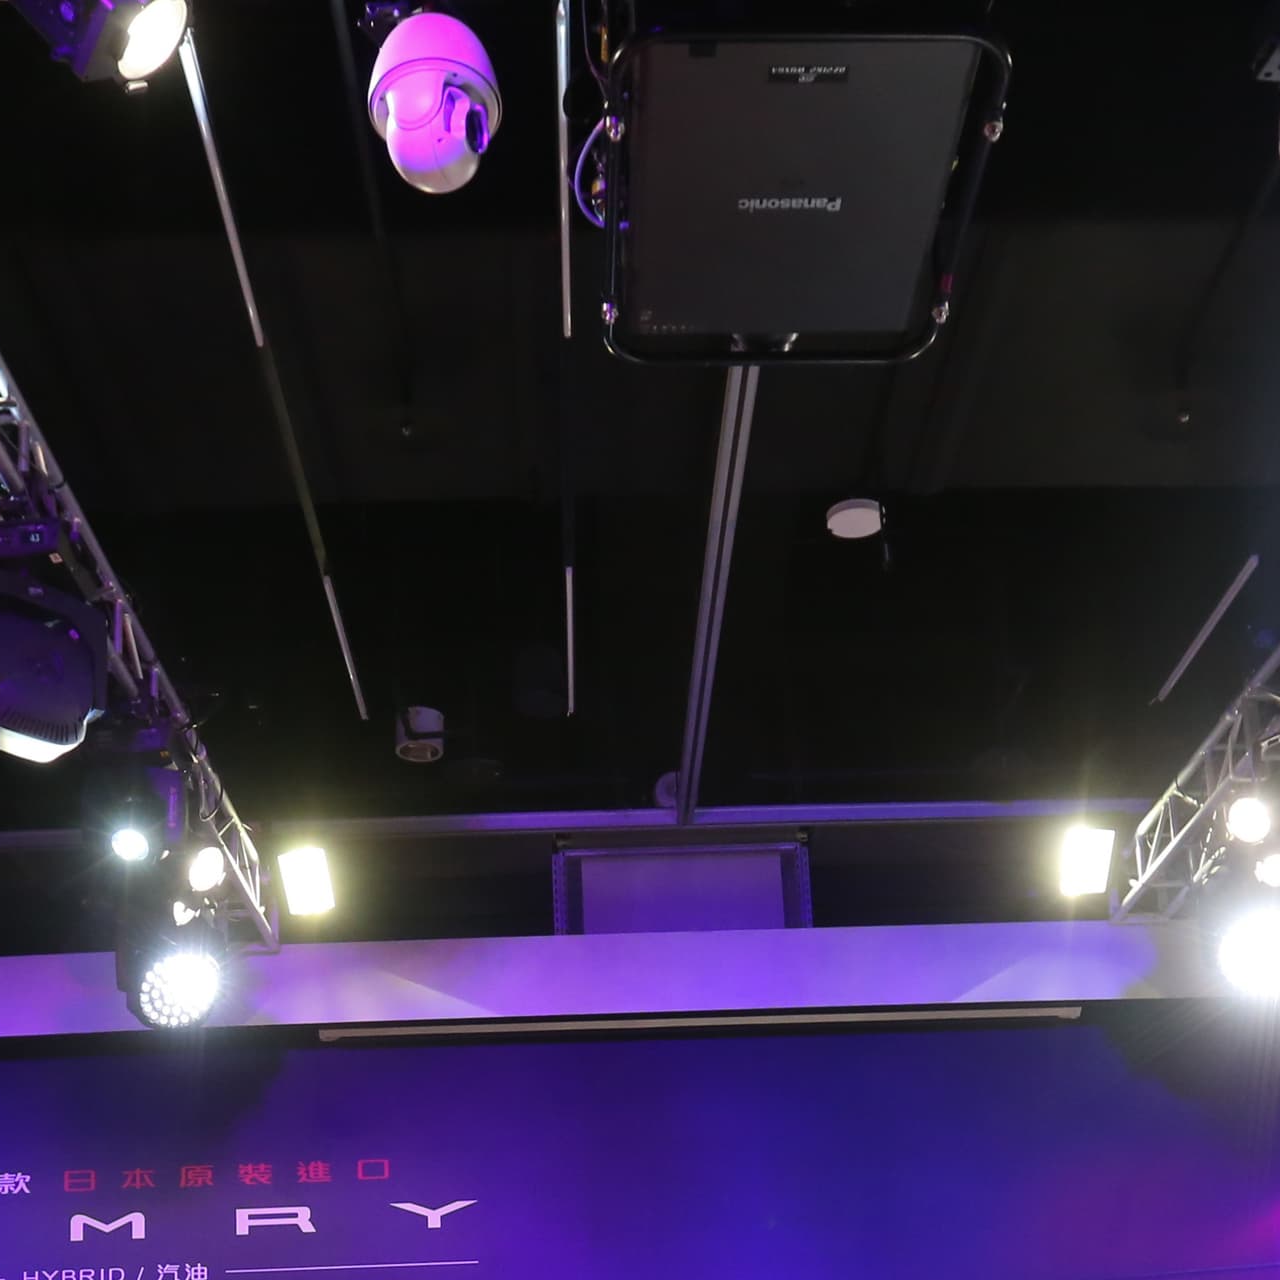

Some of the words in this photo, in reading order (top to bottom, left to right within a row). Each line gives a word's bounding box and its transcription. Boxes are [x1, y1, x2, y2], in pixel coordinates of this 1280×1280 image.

[738, 196, 843, 212] Panasonic
[64, 1159, 390, 1193] 日本原裝進口
